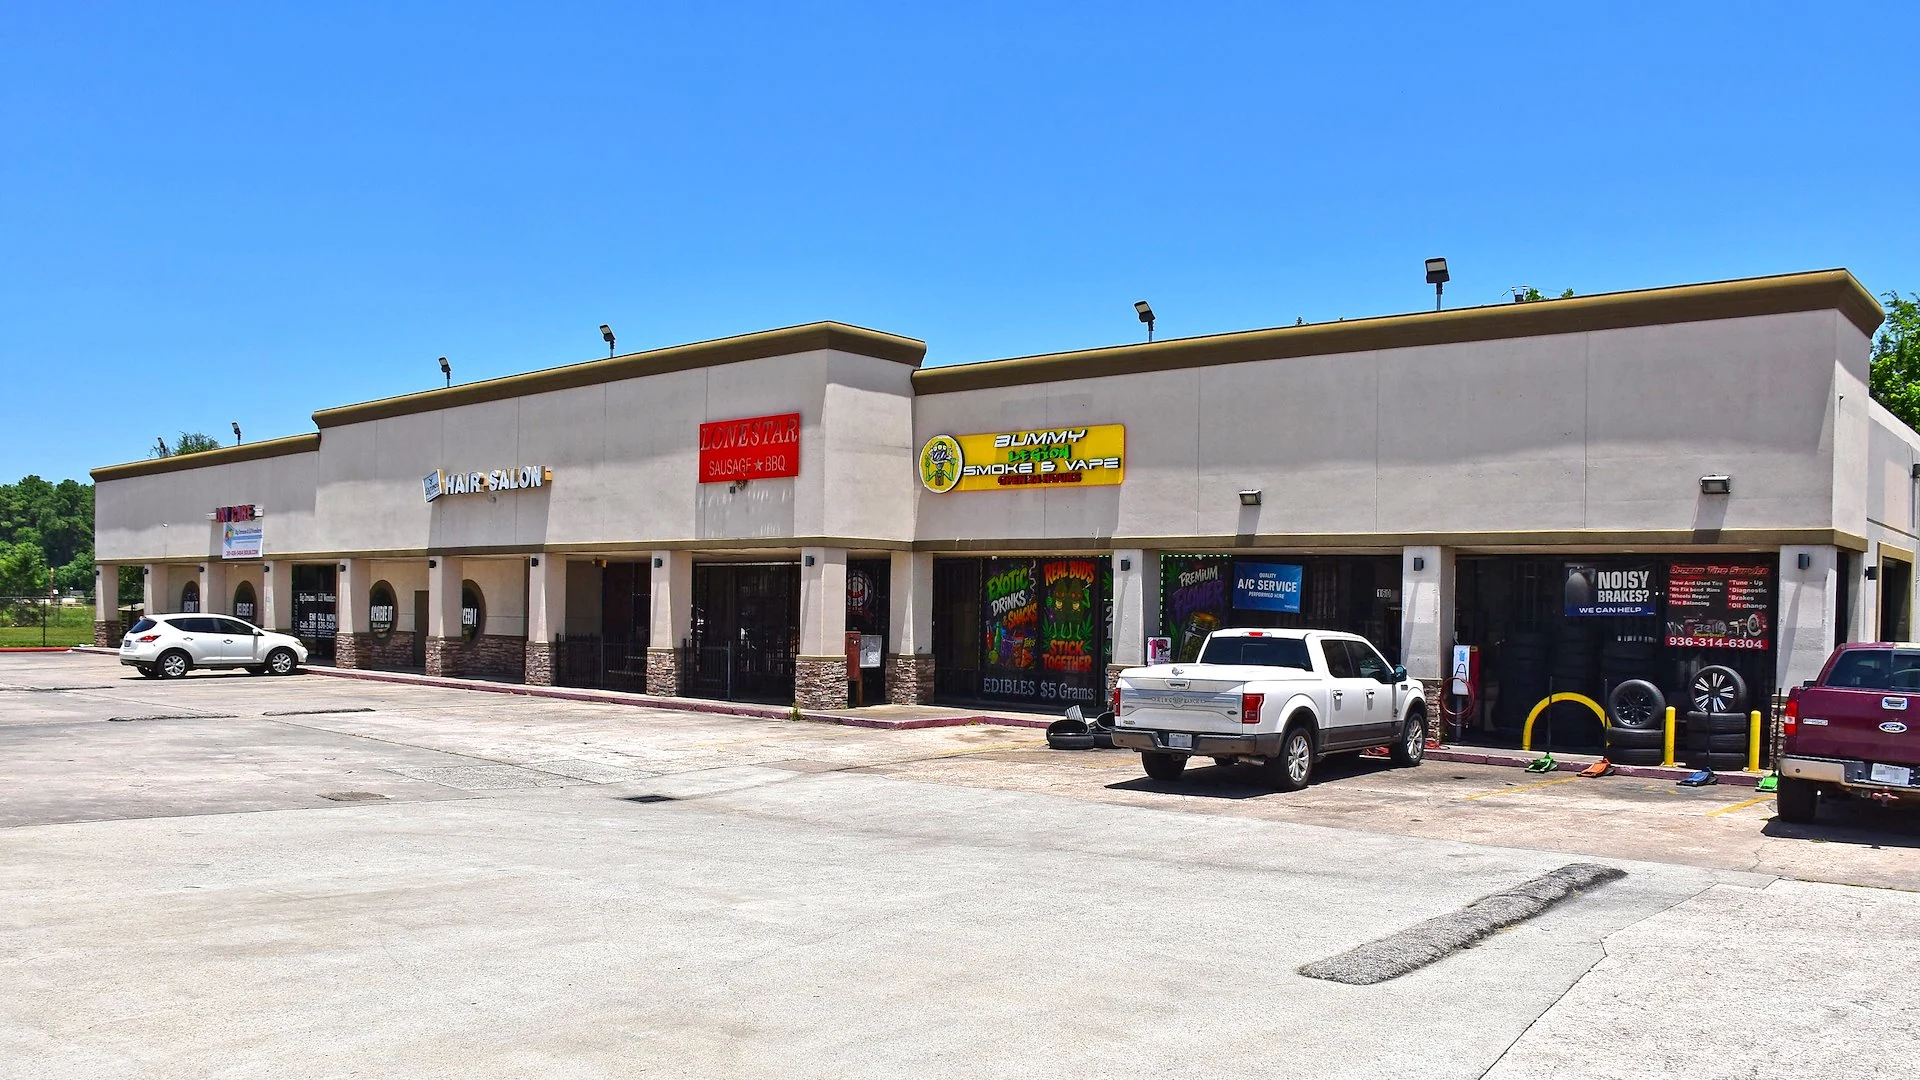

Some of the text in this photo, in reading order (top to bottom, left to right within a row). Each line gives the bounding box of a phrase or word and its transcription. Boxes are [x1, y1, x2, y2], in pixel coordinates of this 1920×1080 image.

[701, 418, 798, 451] LONESTAR
[994, 429, 1087, 448] BUMMY
[765, 455, 786, 472] BBQ
[963, 457, 1120, 476] SMOKE & VAPE
[445, 471, 481, 495] HAIR
[488, 465, 542, 491] SALON
[1044, 560, 1096, 587] REAL BUDS
[1597, 570, 1650, 590] NOISY
[1238, 578, 1298, 593] A/C SERVICE
[1597, 589, 1650, 603] BRAKES?
[1050, 639, 1085, 656] STICK
[1669, 637, 1763, 649] 936-314-6304
[1042, 653, 1092, 672] TOGETHER
[983, 677, 1036, 696] EDIBLES
[1040, 680, 1057, 698] $5
[1059, 682, 1094, 700] Grams
